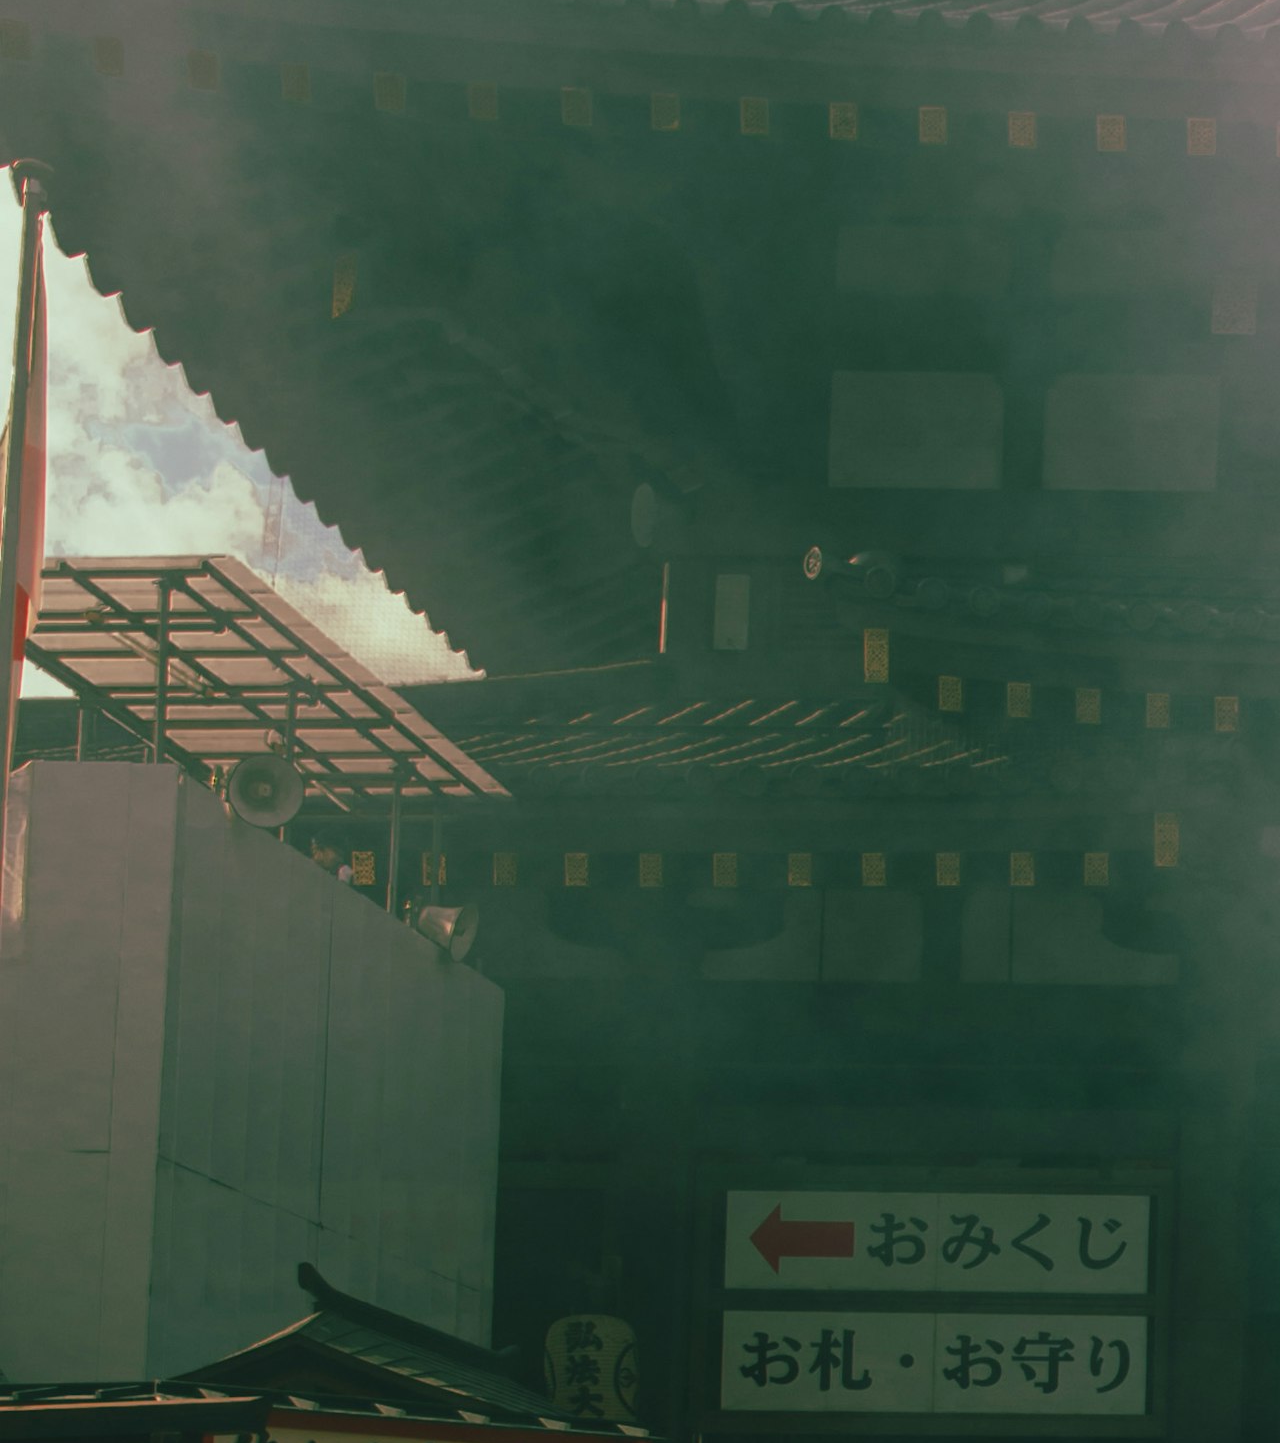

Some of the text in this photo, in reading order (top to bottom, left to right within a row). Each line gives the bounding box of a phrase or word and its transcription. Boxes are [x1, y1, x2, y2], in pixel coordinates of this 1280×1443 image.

[866, 1212, 1128, 1272] おみくじ
[739, 1328, 1131, 1395] お札・お守り
